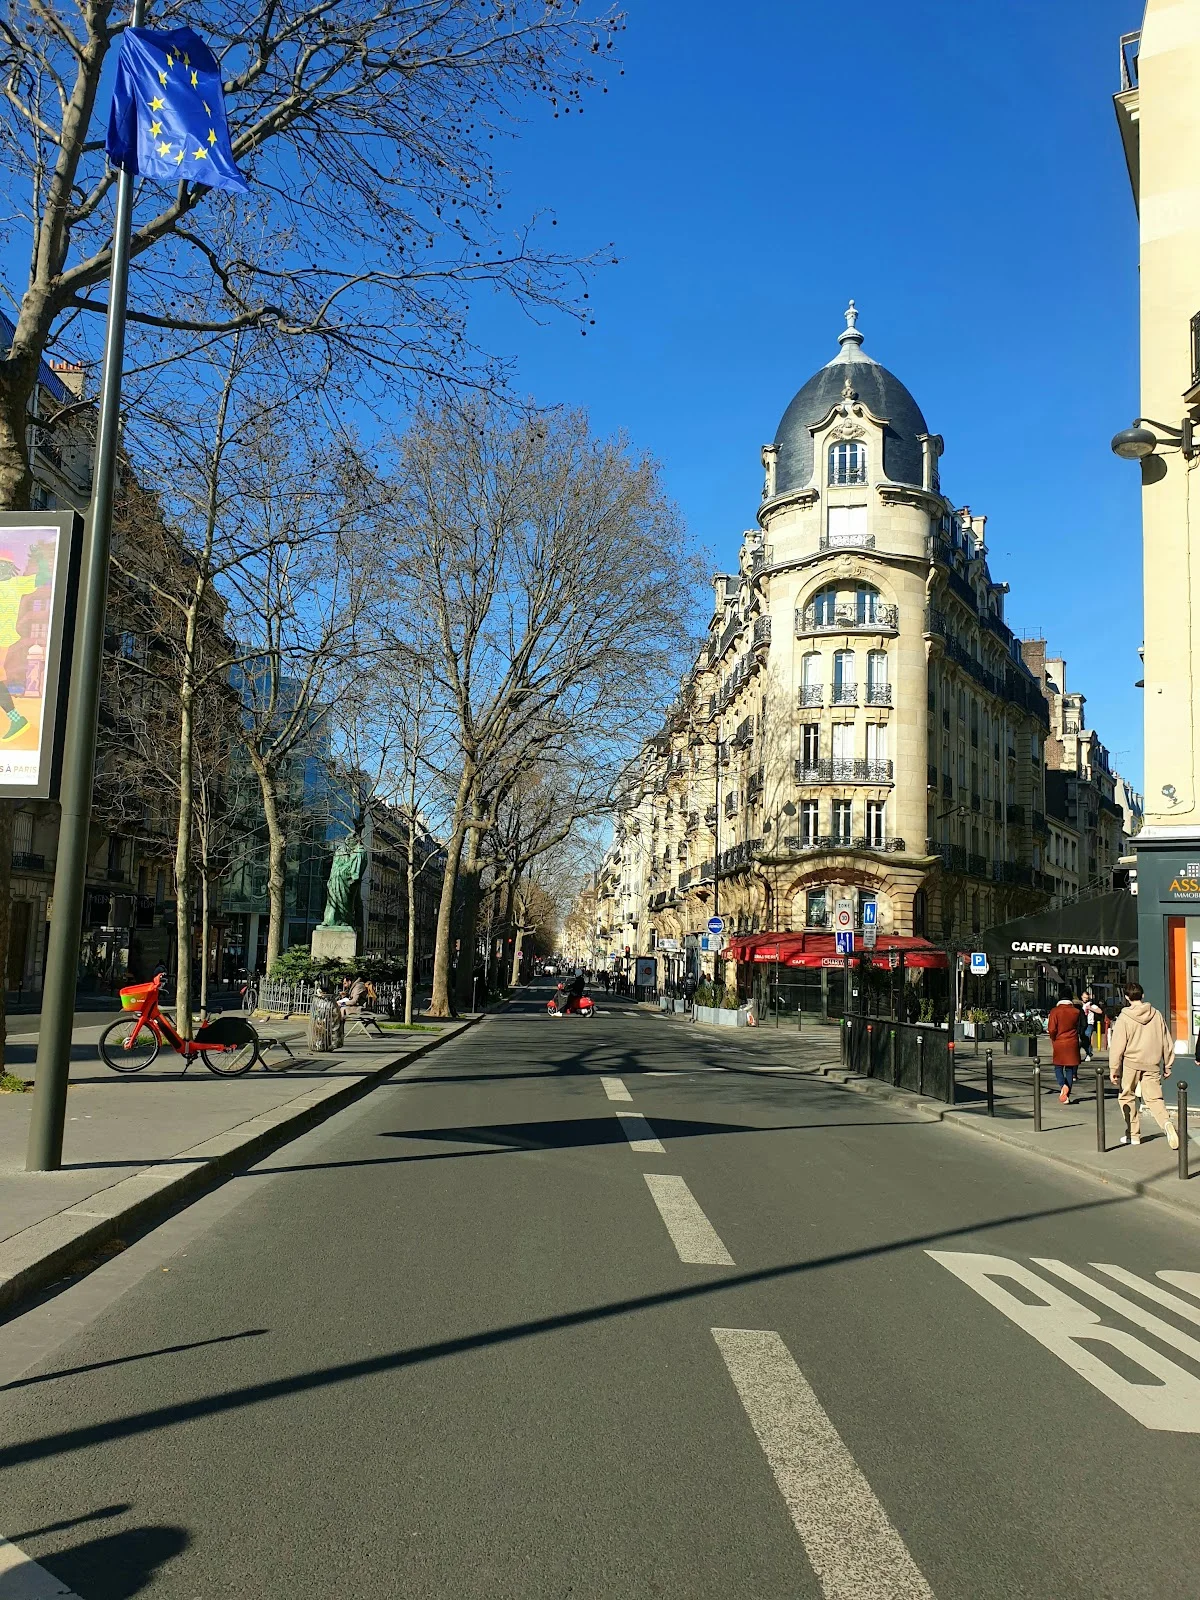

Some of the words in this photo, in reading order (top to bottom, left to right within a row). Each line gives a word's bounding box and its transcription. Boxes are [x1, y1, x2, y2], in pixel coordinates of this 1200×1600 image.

[5, 763, 12, 773] À
[13, 765, 37, 773] PARIS
[1169, 878, 1200, 892] ASS
[1011, 941, 1052, 953] CAFFE
[1057, 943, 1120, 957] ITALIANO
[975, 955, 983, 965] P
